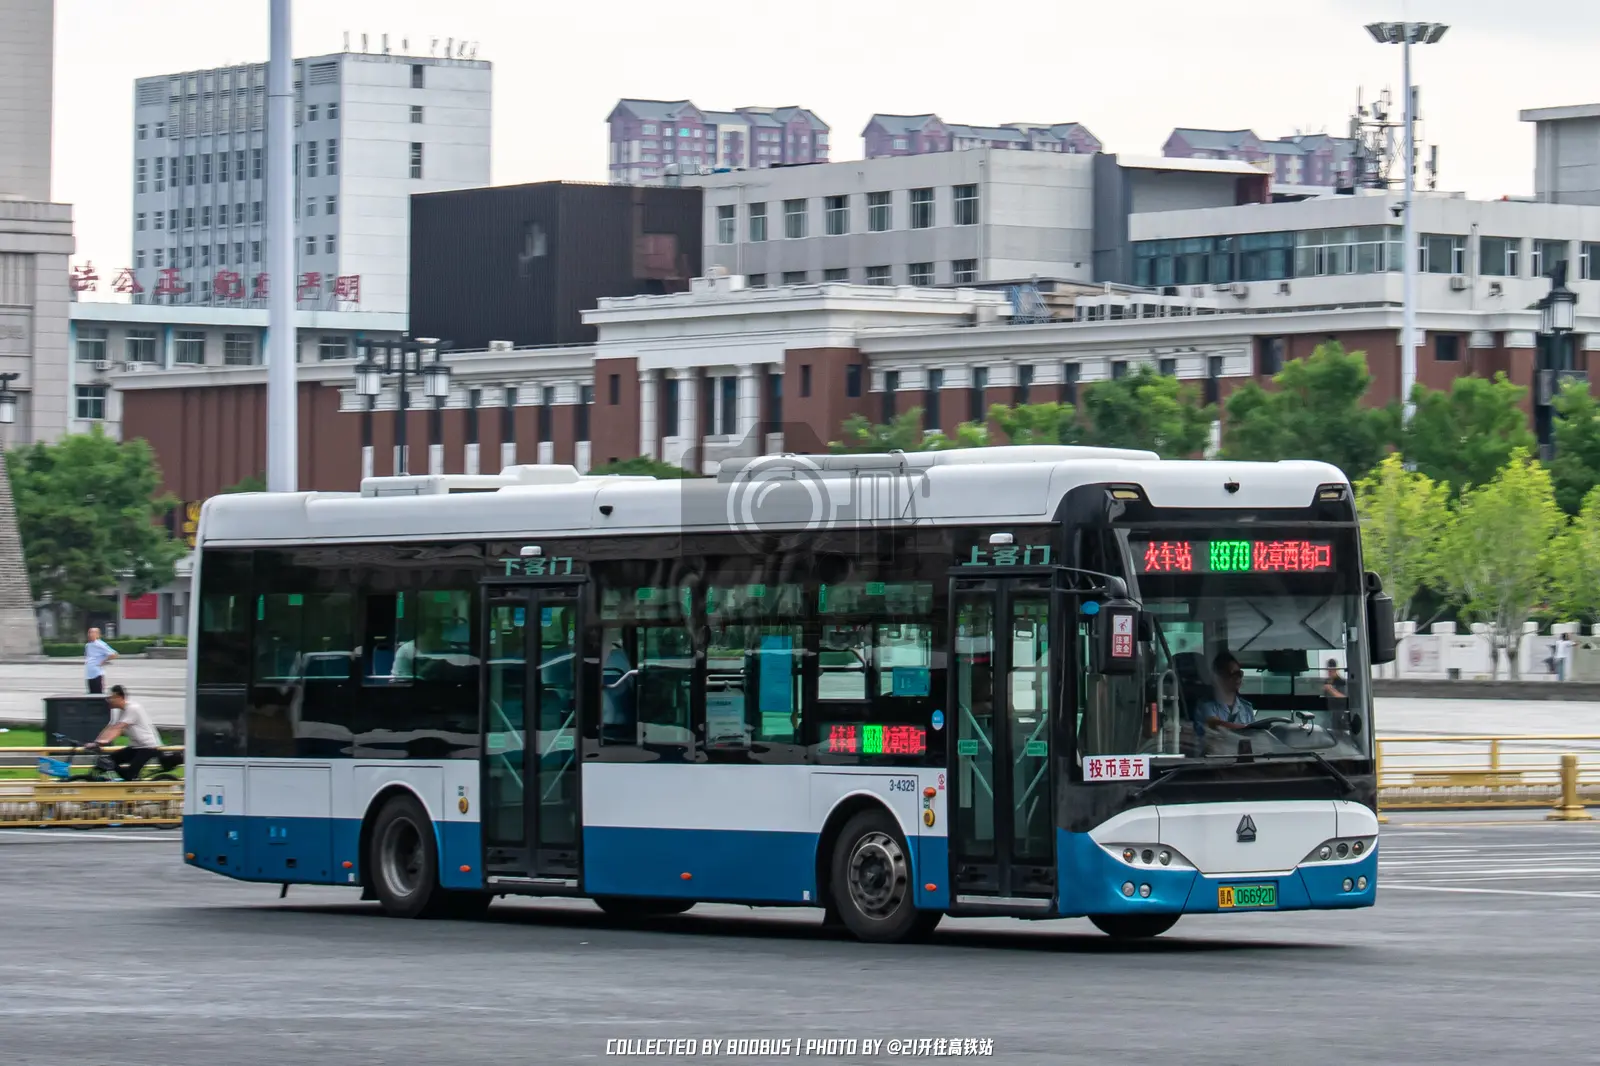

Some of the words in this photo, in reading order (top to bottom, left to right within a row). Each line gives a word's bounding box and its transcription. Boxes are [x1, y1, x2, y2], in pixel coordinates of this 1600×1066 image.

[961, 544, 1051, 566] 上客门
[1144, 541, 1193, 571] 火车站
[1210, 541, 1250, 571] K870
[498, 556, 573, 576] 下客门
[1089, 758, 1144, 778] 投币壹元
